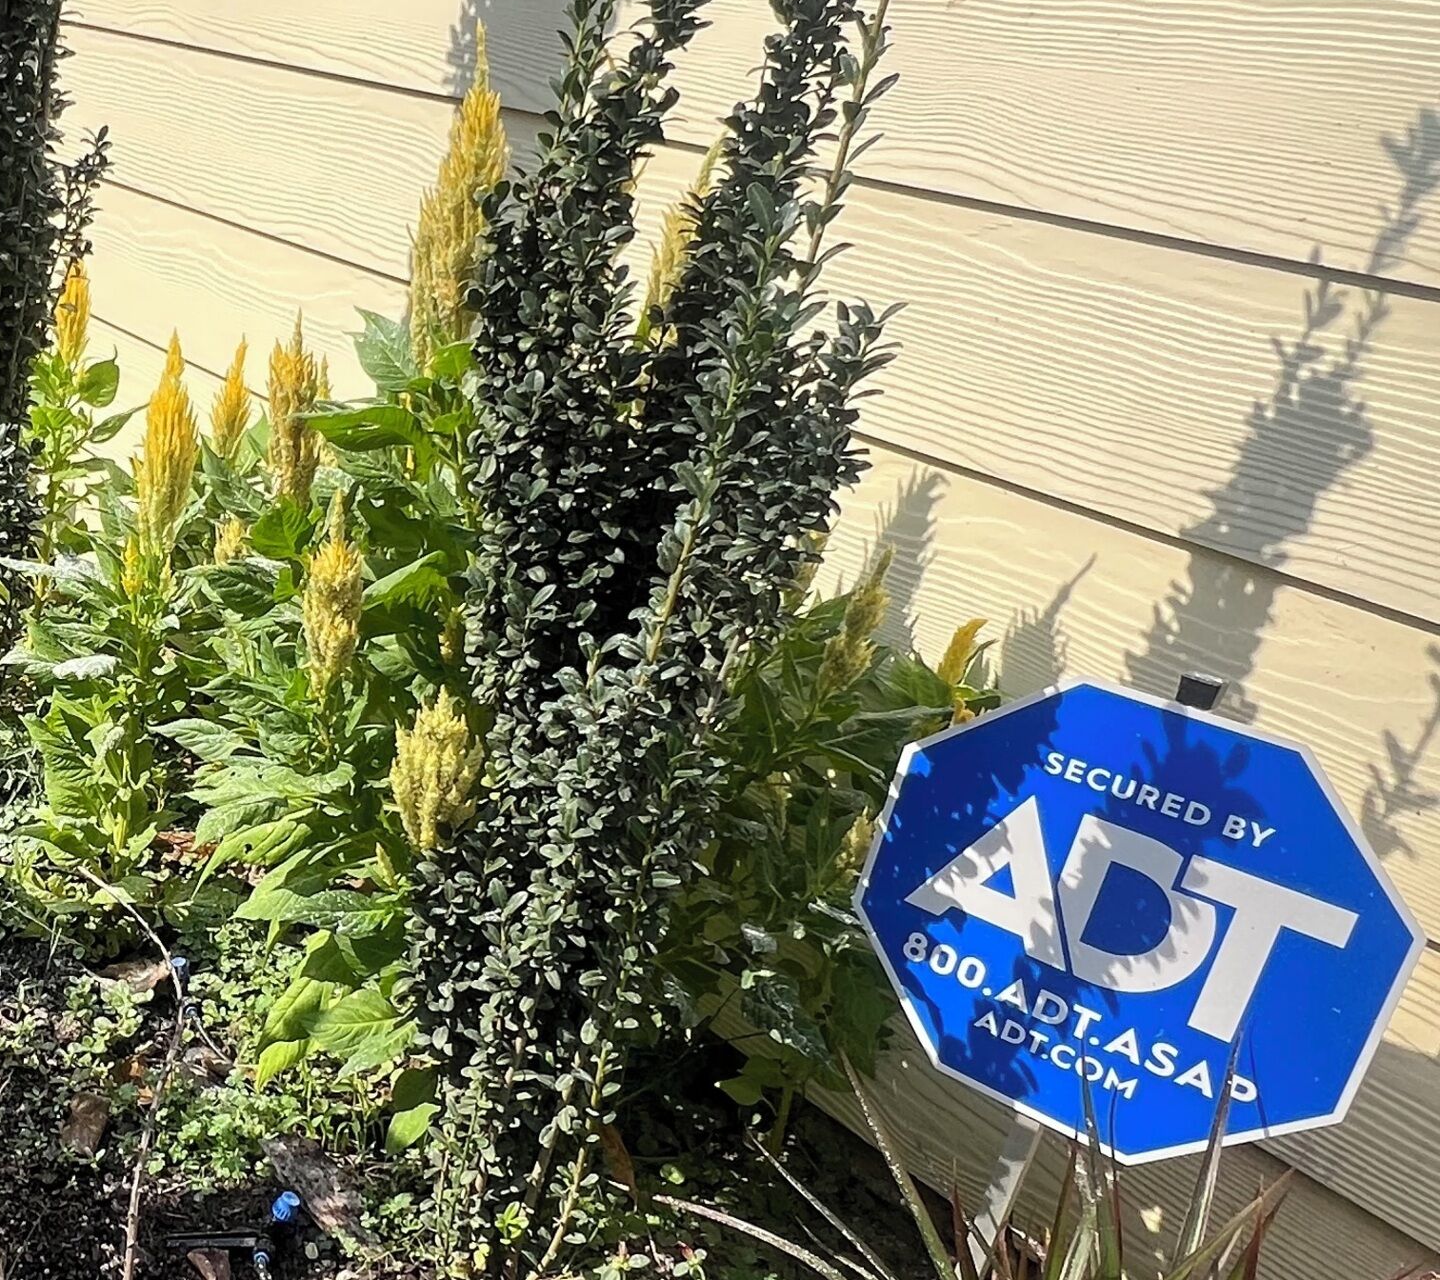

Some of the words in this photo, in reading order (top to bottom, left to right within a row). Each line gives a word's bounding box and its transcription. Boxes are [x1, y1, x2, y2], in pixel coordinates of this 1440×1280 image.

[1046, 752, 1211, 827] SECURED
[1222, 815, 1276, 849] BY
[904, 795, 1359, 1044] ADT
[974, 1013, 1138, 1100] ADT.COM
